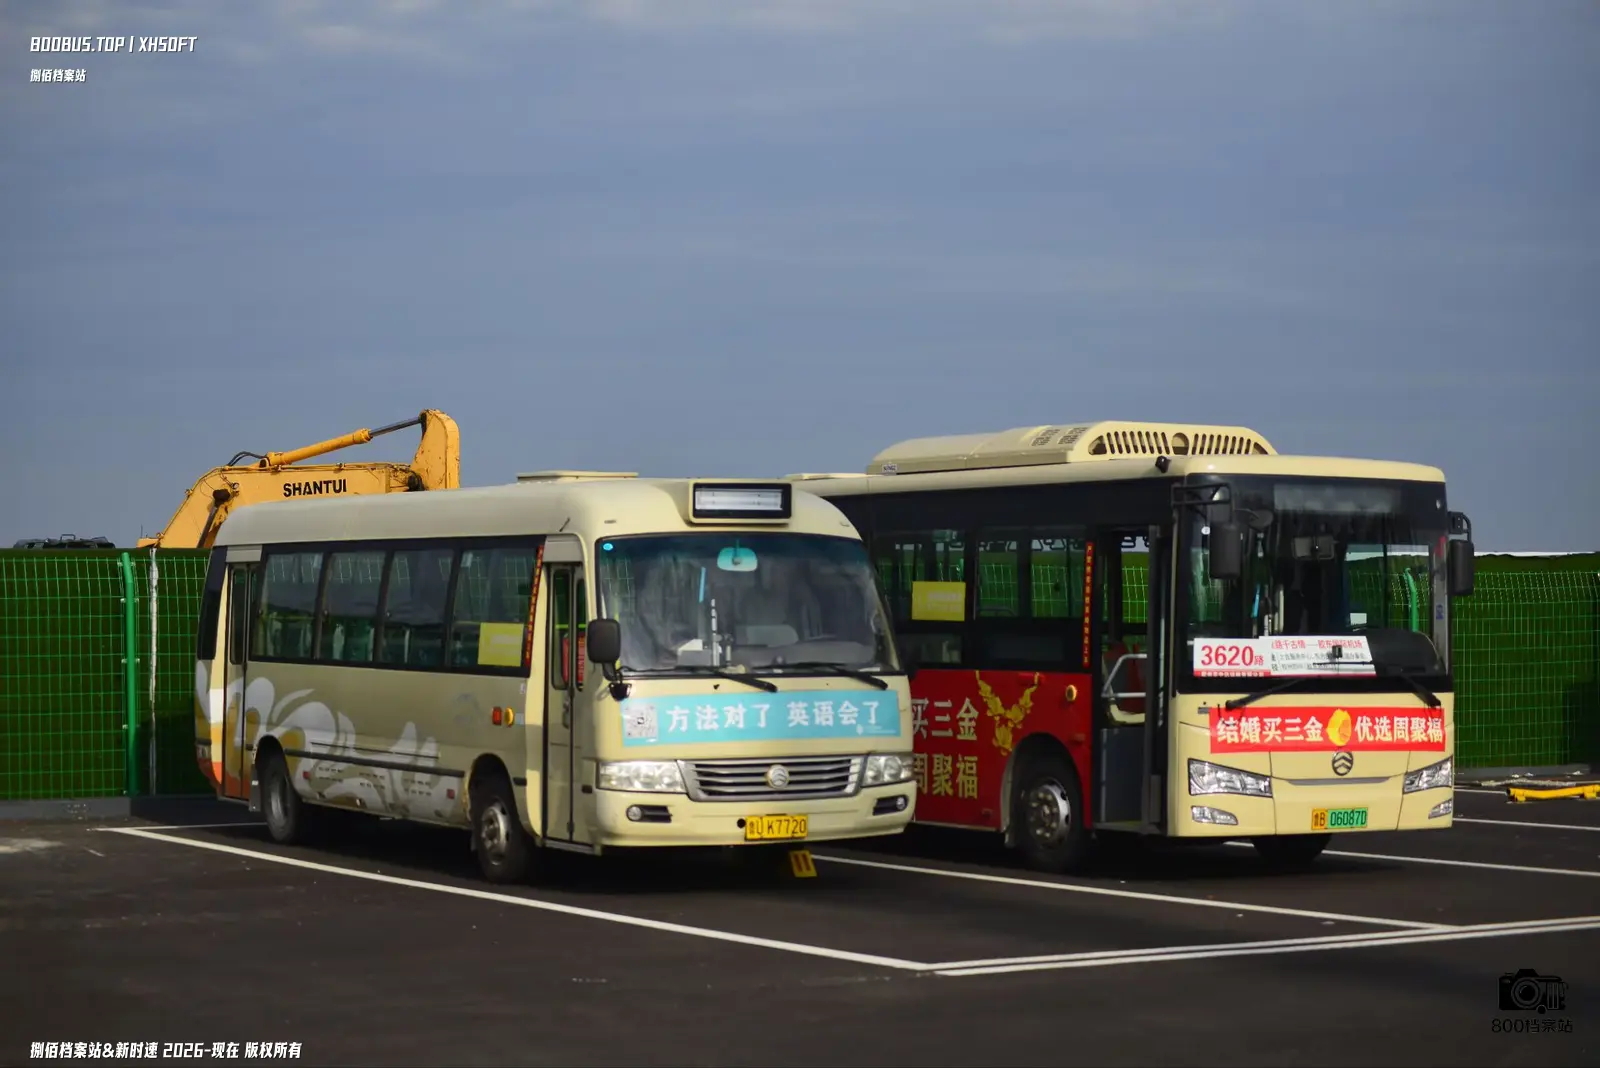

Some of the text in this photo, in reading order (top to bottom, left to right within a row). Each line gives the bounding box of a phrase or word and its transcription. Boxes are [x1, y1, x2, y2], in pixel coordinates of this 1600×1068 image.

[283, 478, 347, 498] SHANTUI
[1201, 645, 1265, 667] 3620路
[666, 700, 880, 733] 方法对了 英语会了
[911, 697, 980, 741] 买三金
[1216, 714, 1444, 744] 结婚买三金 优选周聚福
[913, 752, 979, 800] 周聚福
